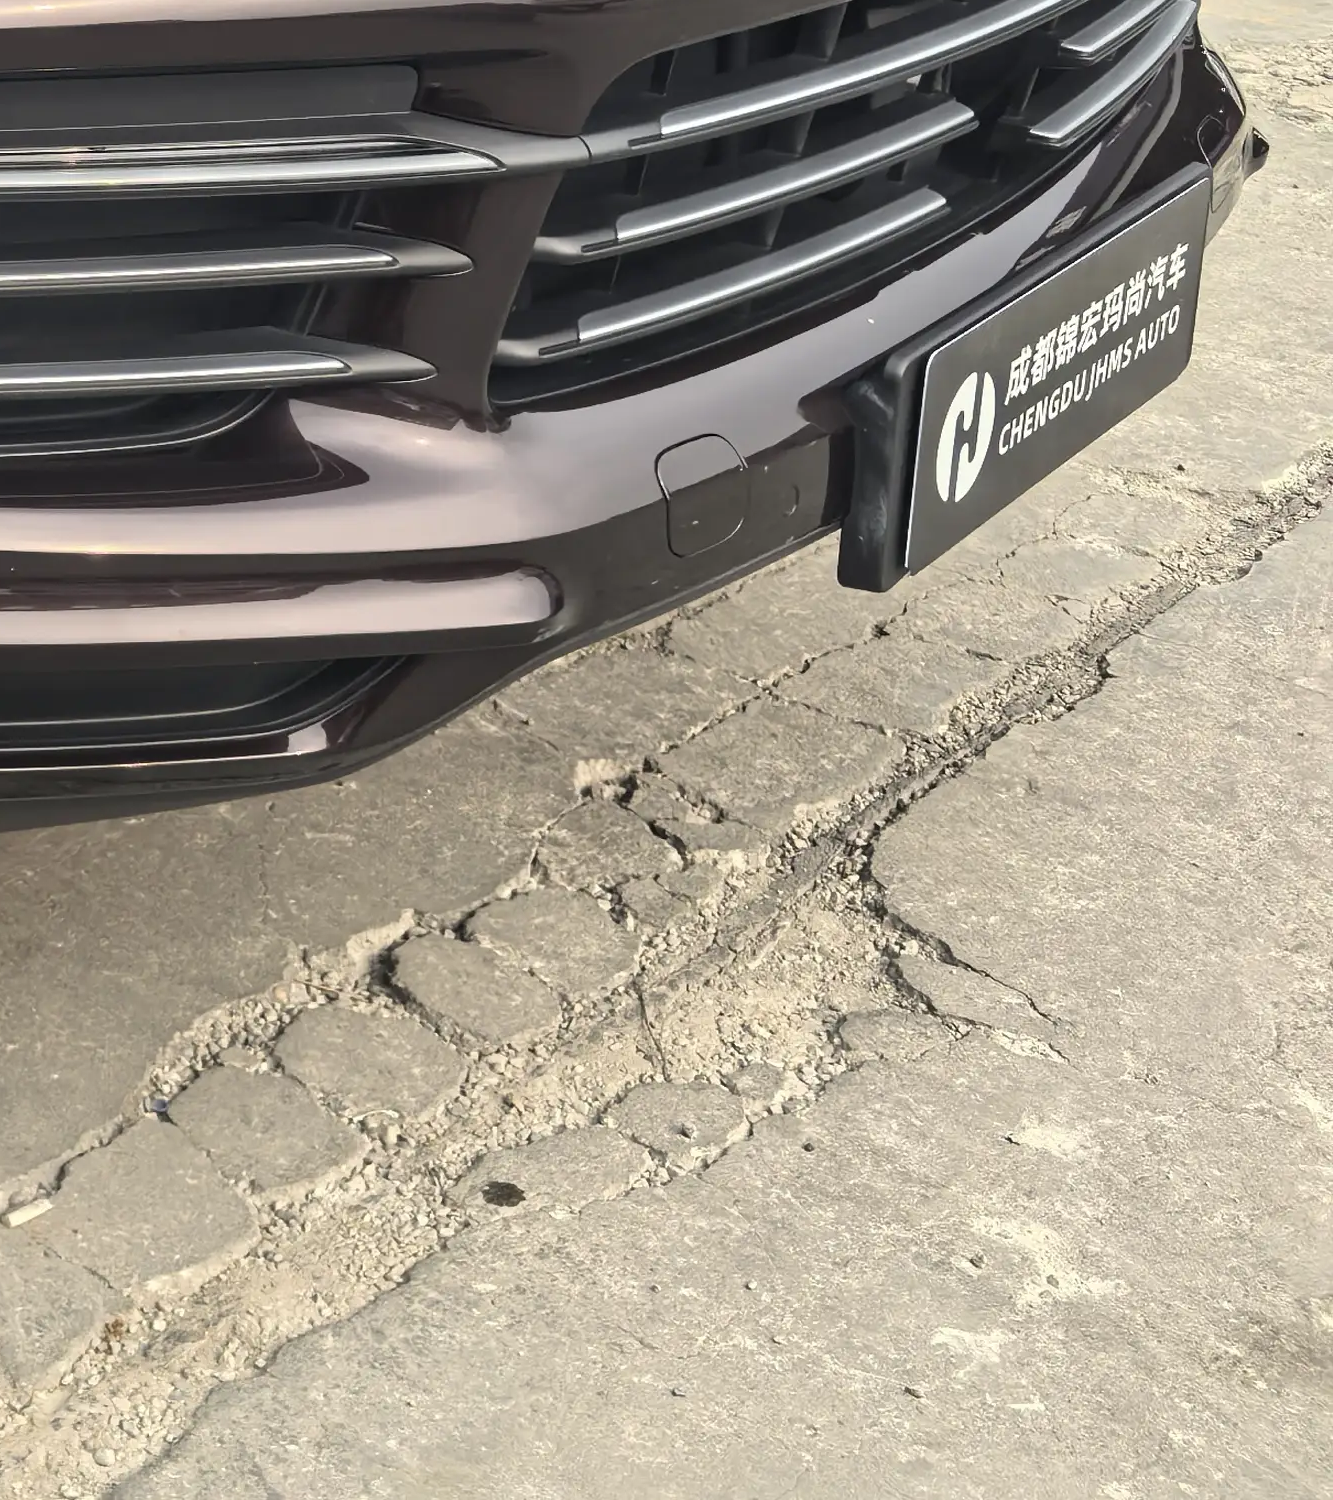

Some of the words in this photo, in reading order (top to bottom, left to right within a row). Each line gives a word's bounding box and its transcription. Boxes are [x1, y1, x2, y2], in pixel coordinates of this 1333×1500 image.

[998, 369, 1088, 456] CHENGDU
[1084, 336, 1134, 402] JHMS
[1134, 304, 1181, 361] AUTO
[1004, 243, 1190, 406] 成都锦宏玛尚汽车
